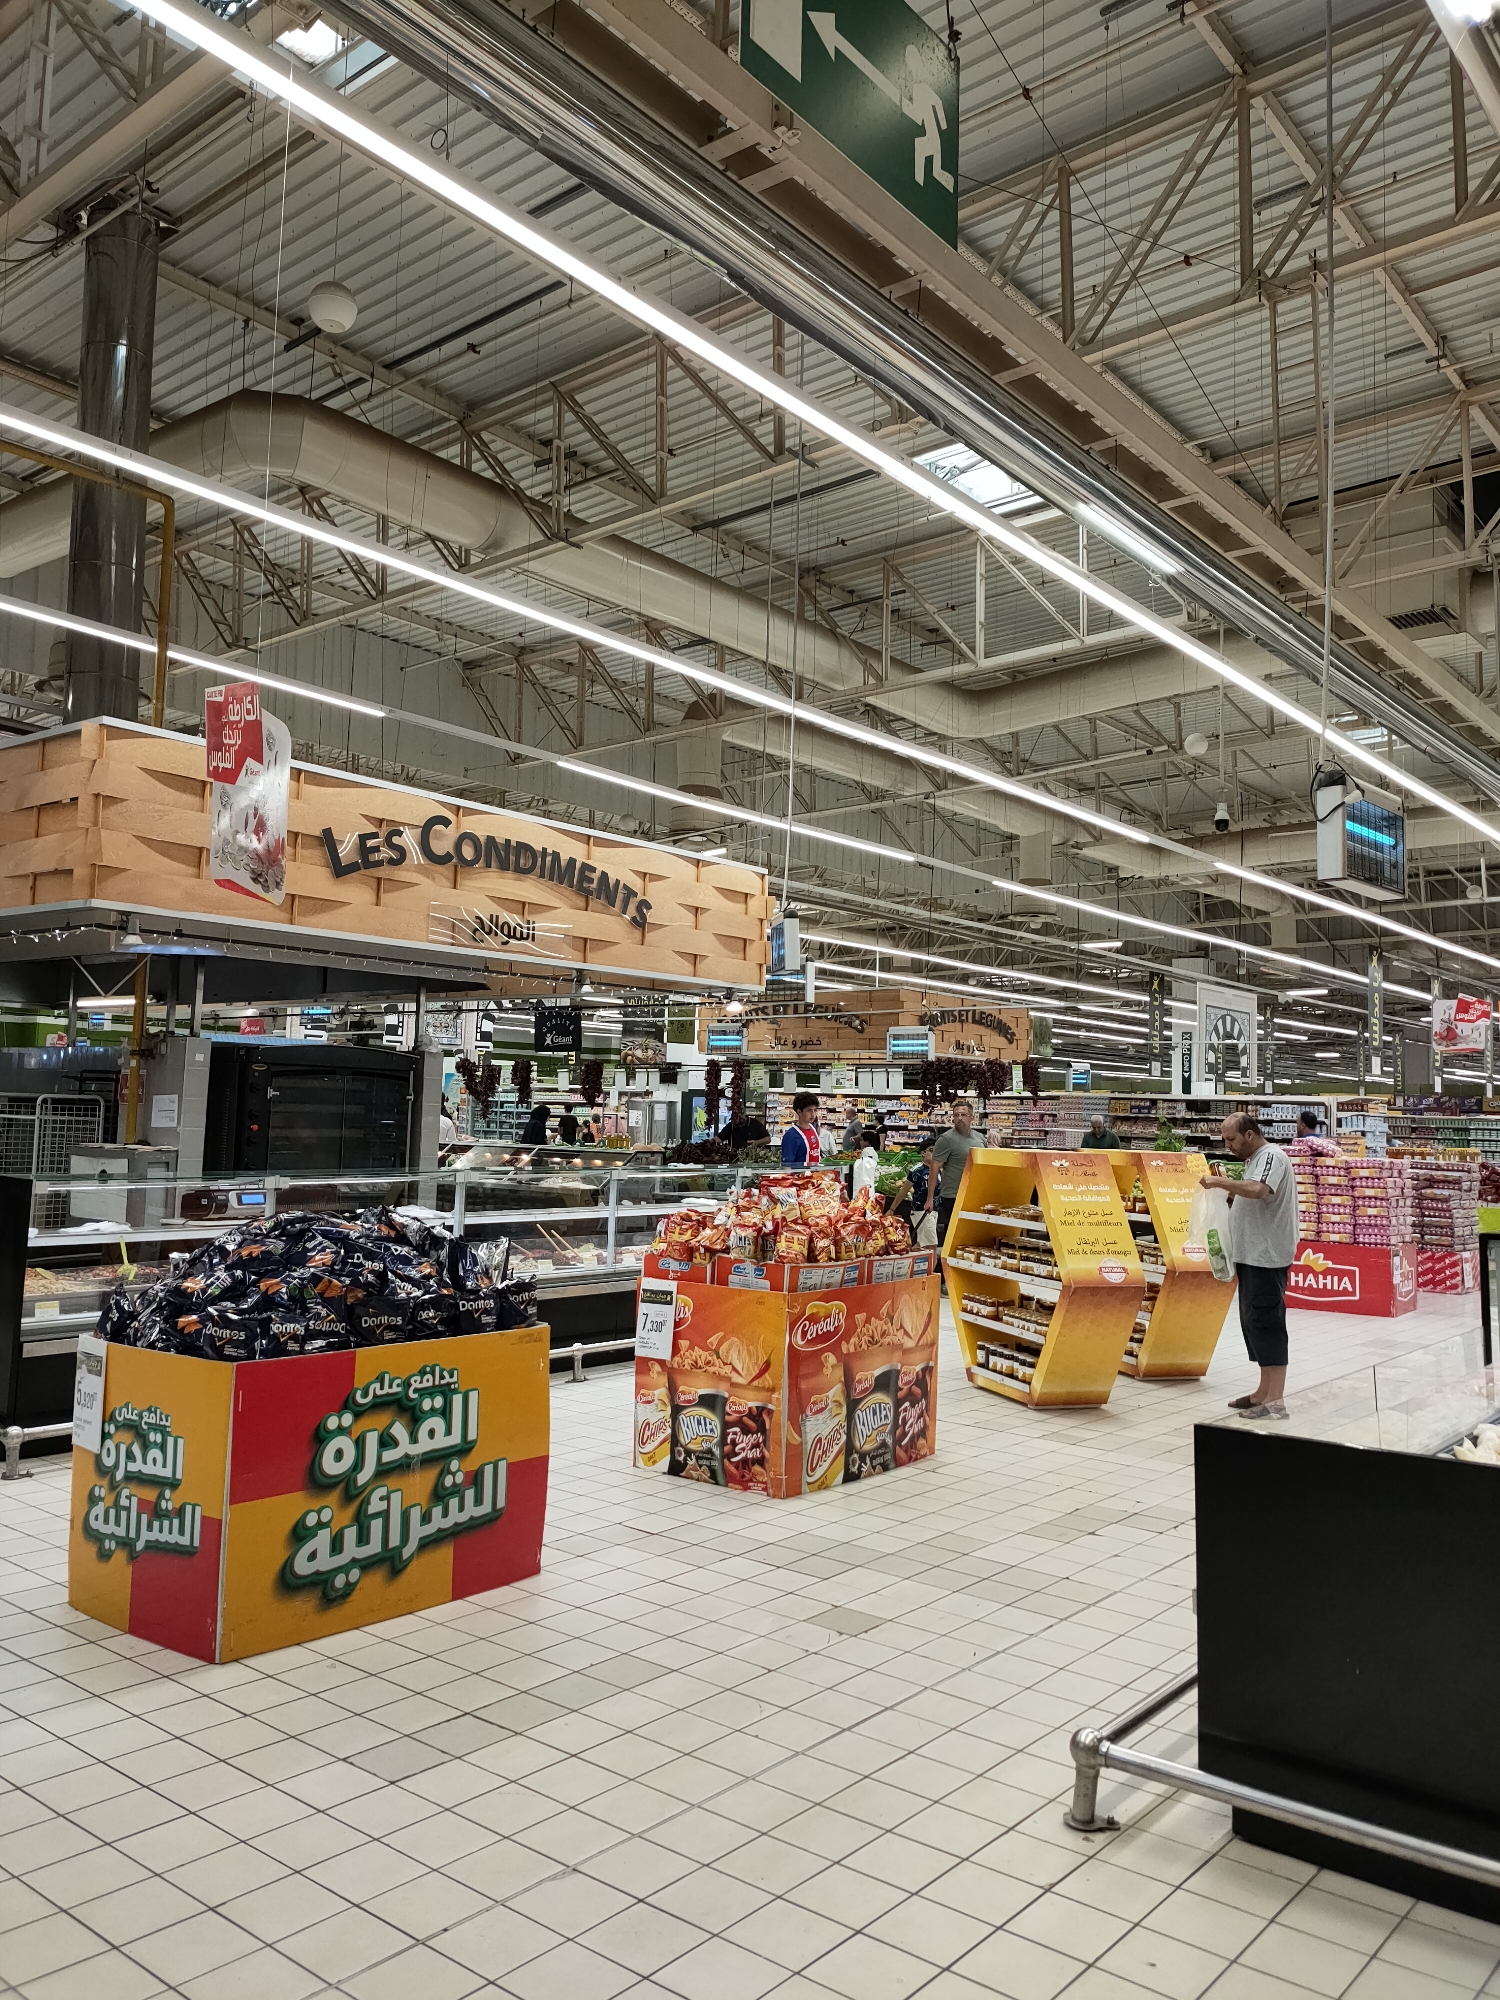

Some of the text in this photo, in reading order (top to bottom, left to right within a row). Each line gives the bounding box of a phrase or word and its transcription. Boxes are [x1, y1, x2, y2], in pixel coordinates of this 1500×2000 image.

[228, 695, 260, 727] الكارطة
[208, 746, 234, 773] الفلوس
[321, 815, 653, 929] LES CONDIMENTS
[471, 913, 536, 946] الموالح
[958, 1009, 970, 1023] ET
[553, 1035, 572, 1043] Géant
[799, 1036, 822, 1050] خضر
[1182, 1032, 1191, 1054] PRIX
[1076, 1237, 1118, 1247] عسل البرتقال
[1286, 1272, 1353, 1292] HAHIA
[459, 1299, 494, 1311] Doritos
[206, 1323, 246, 1340] Doritos
[362, 1316, 402, 1328] Doritos
[642, 1312, 662, 1333] 7,330
[798, 1306, 844, 1345] Céréalis
[355, 1364, 459, 1405] يدافع على
[115, 1404, 171, 1432] يدافع على
[680, 1414, 718, 1444] BUGLES
[855, 1403, 891, 1449] BUGLES
[321, 1390, 478, 1487] القدرة
[727, 1427, 764, 1447] Finger
[101, 1422, 184, 1481] القدرة
[731, 1443, 762, 1462] Snax
[88, 1485, 200, 1552] الشرائية
[293, 1458, 507, 1589] الشرائية
